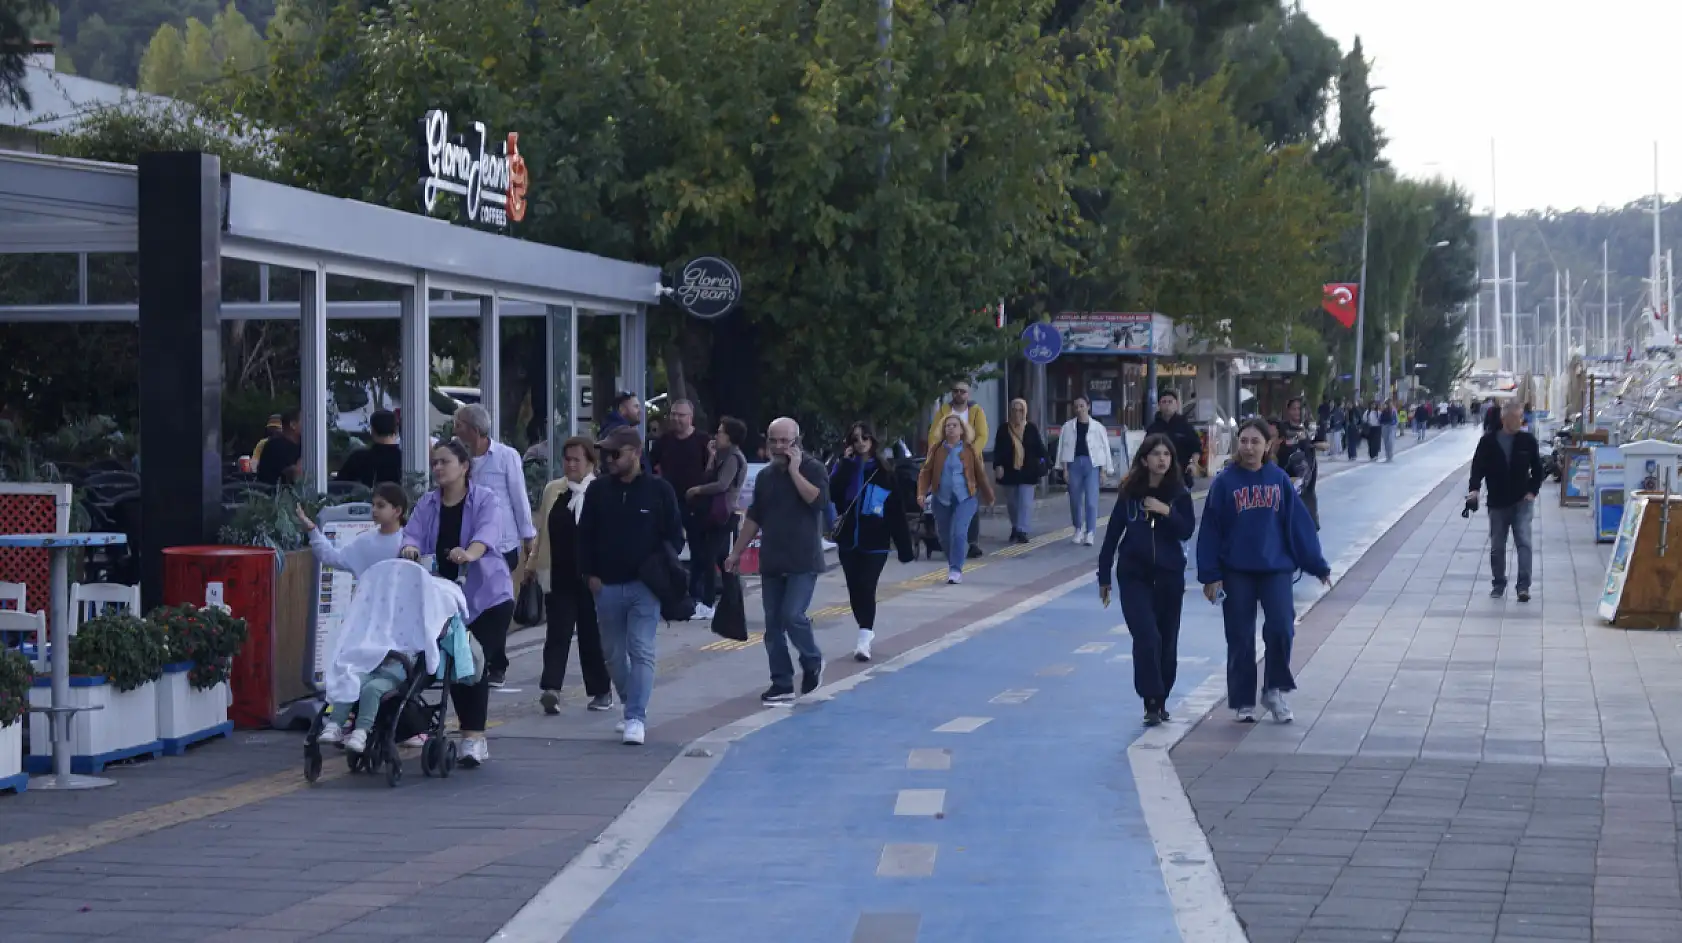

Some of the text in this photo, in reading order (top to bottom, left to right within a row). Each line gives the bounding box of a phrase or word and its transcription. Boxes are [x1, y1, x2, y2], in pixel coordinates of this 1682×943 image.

[425, 110, 471, 212] Gloria
[480, 206, 507, 226] COFFEES
[678, 268, 732, 295] Gloria
[683, 288, 735, 306] Jean's
[1234, 484, 1280, 512] MAVI
